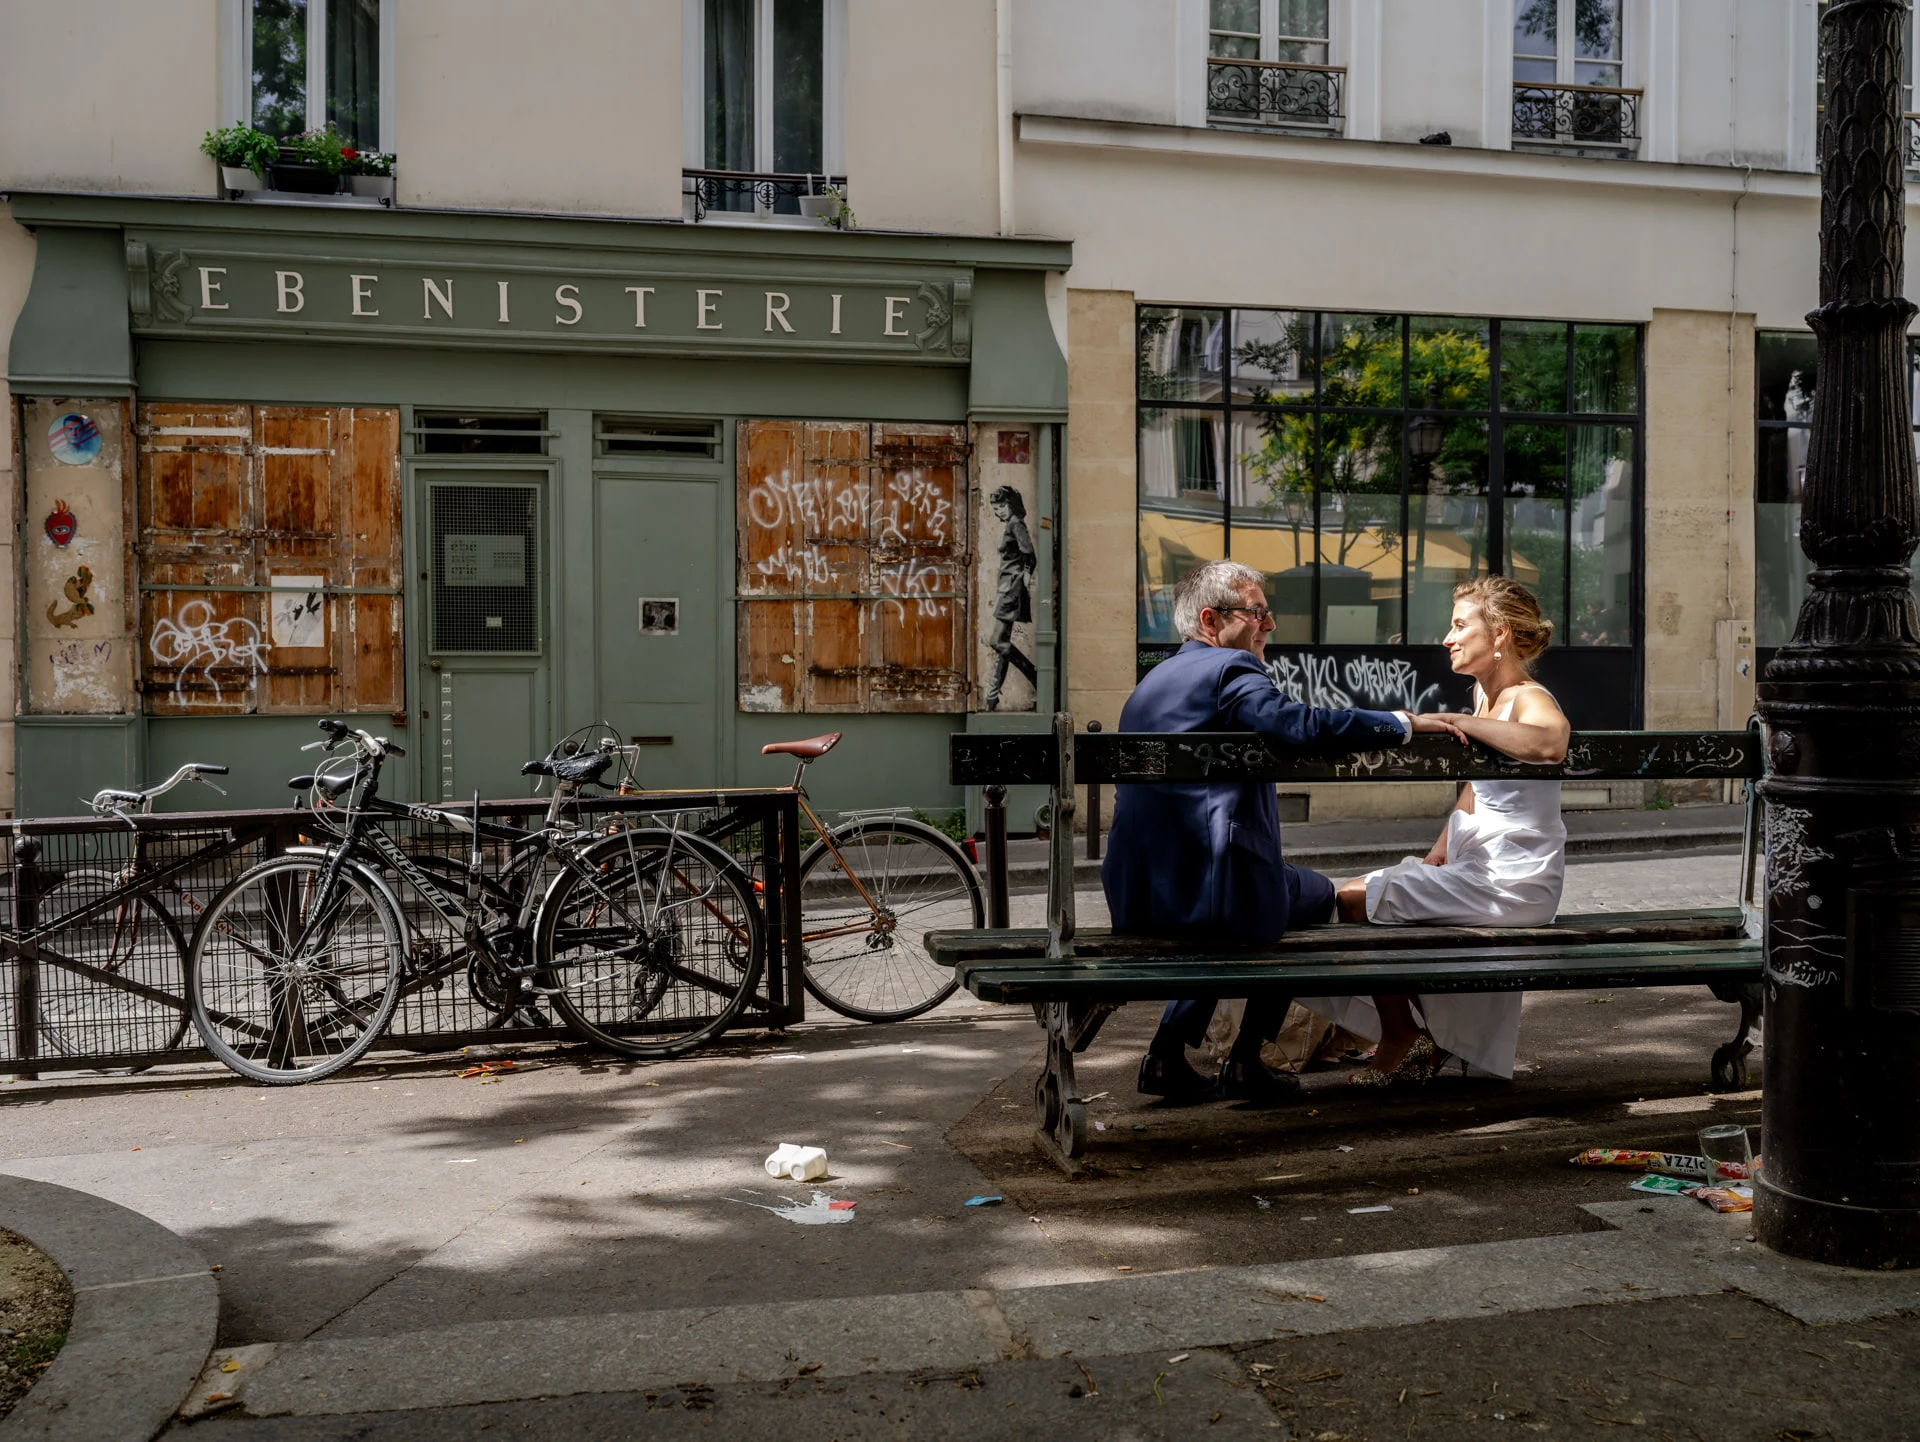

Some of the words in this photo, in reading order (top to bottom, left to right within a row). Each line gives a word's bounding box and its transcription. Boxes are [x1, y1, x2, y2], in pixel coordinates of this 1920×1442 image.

[199, 266, 911, 337] EBENISTERIE
[441, 671, 453, 798] EBENISTERI
[407, 804, 440, 823] T435
[366, 827, 451, 908] TORPADO
[1663, 1154, 1706, 1170] PIZZA
